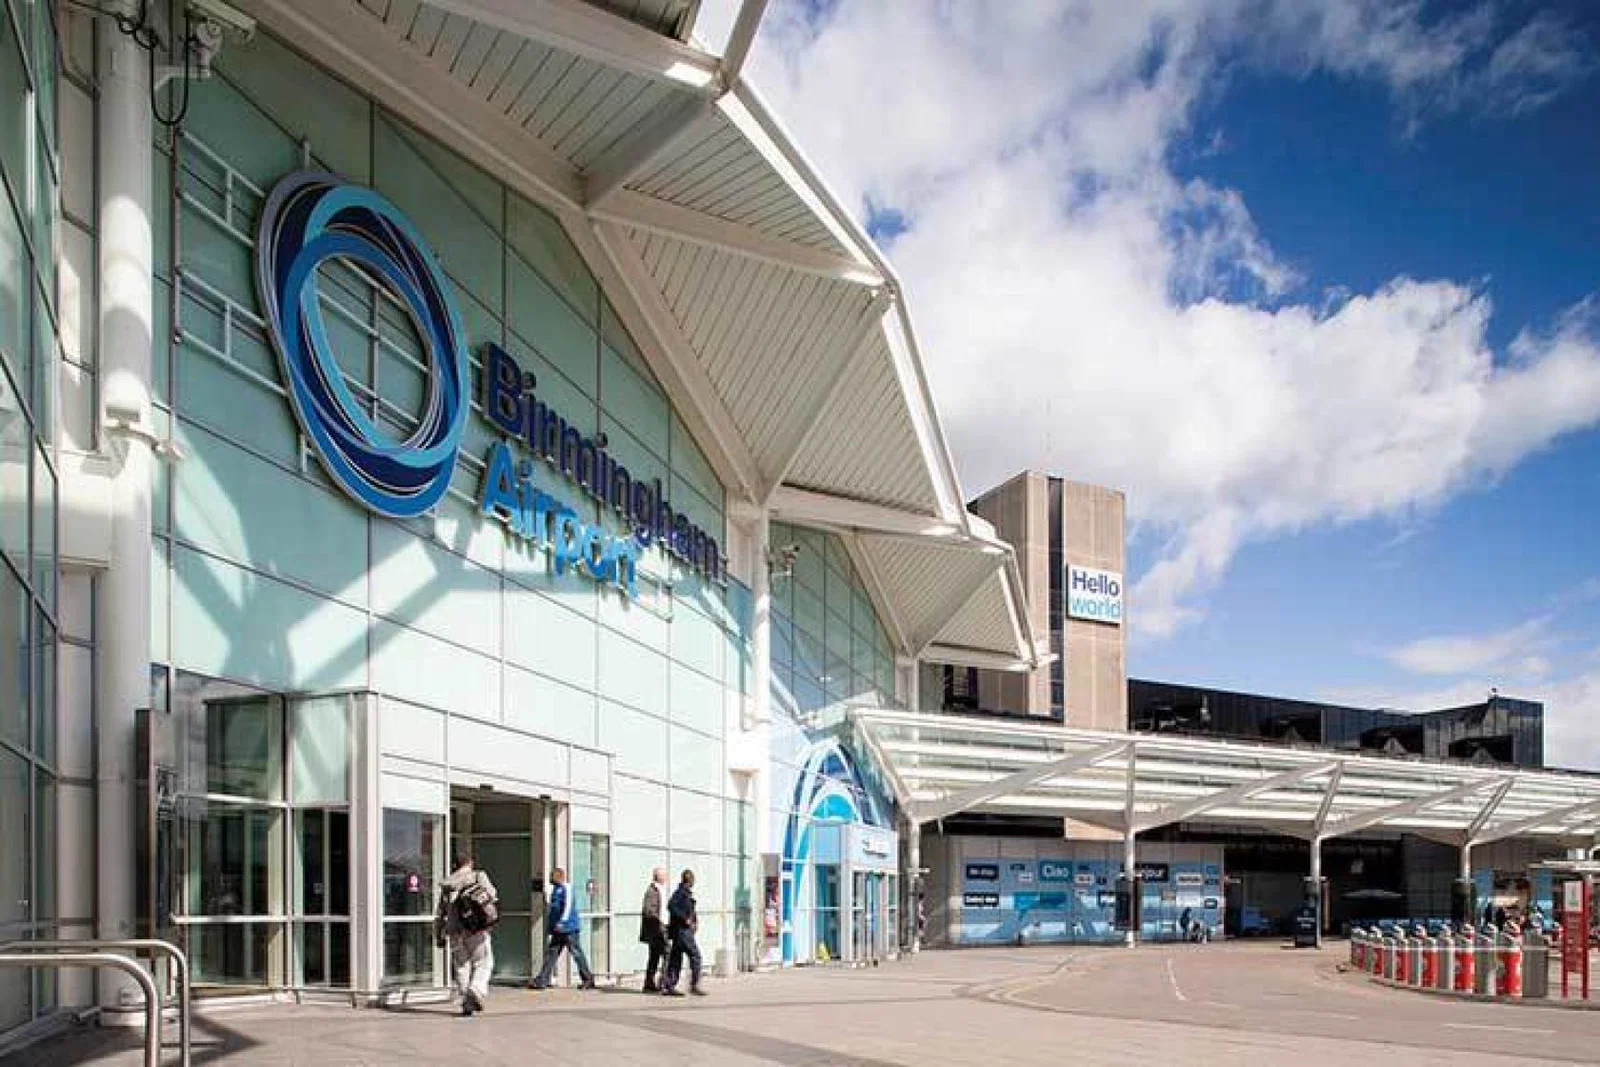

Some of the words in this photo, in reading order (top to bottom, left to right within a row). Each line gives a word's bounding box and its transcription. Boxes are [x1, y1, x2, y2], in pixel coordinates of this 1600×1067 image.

[481, 341, 727, 586] Birmingham
[481, 439, 640, 601] Airport
[1072, 568, 1120, 597] Hello
